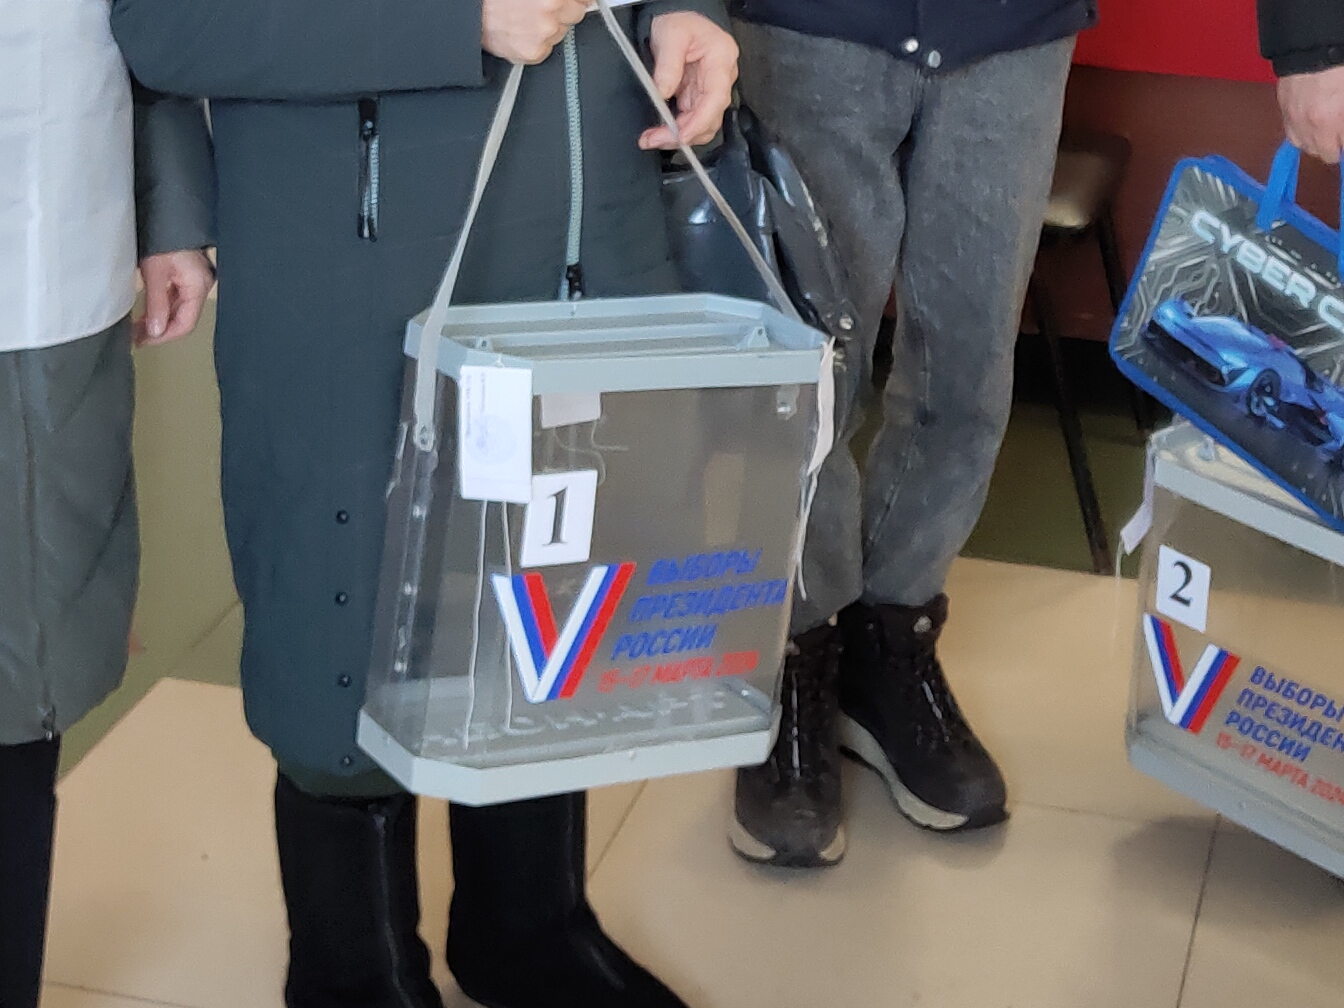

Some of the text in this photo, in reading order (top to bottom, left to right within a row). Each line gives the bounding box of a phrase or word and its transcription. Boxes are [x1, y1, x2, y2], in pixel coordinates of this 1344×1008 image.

[1189, 208, 1316, 310] CYBER
[542, 486, 570, 548] 1
[1169, 560, 1194, 608] 2
[610, 623, 719, 661] РОССИИ
[1223, 709, 1312, 763] РОССИИ
